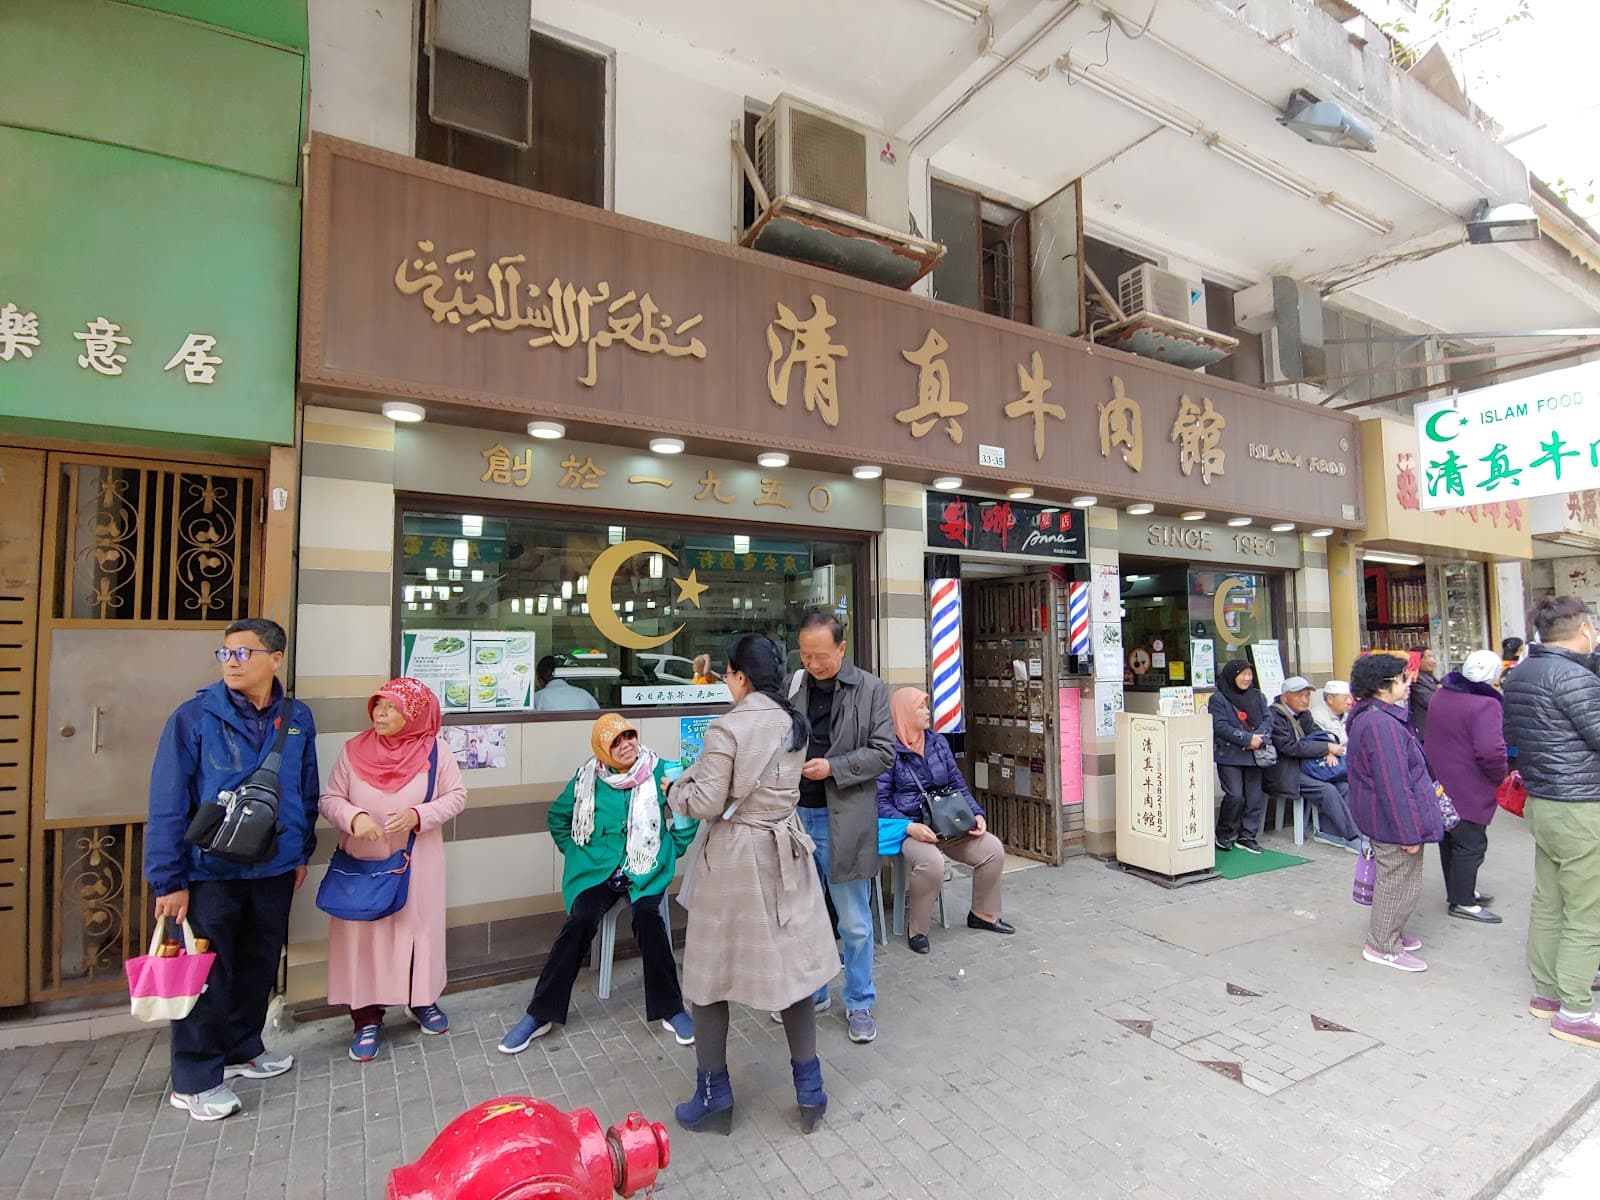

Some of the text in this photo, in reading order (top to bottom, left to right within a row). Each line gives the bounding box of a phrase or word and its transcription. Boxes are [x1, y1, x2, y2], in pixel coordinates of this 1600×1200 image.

[767, 295, 1226, 486] 清真牛肉館
[1481, 392, 1583, 425] ISLAM FOOD
[1425, 430, 1600, 498] 清真牛
[1021, 530, 1077, 551] Anna
[1147, 523, 1278, 557] SINCE 1950
[1142, 737, 1155, 827] 清真牛肉館
